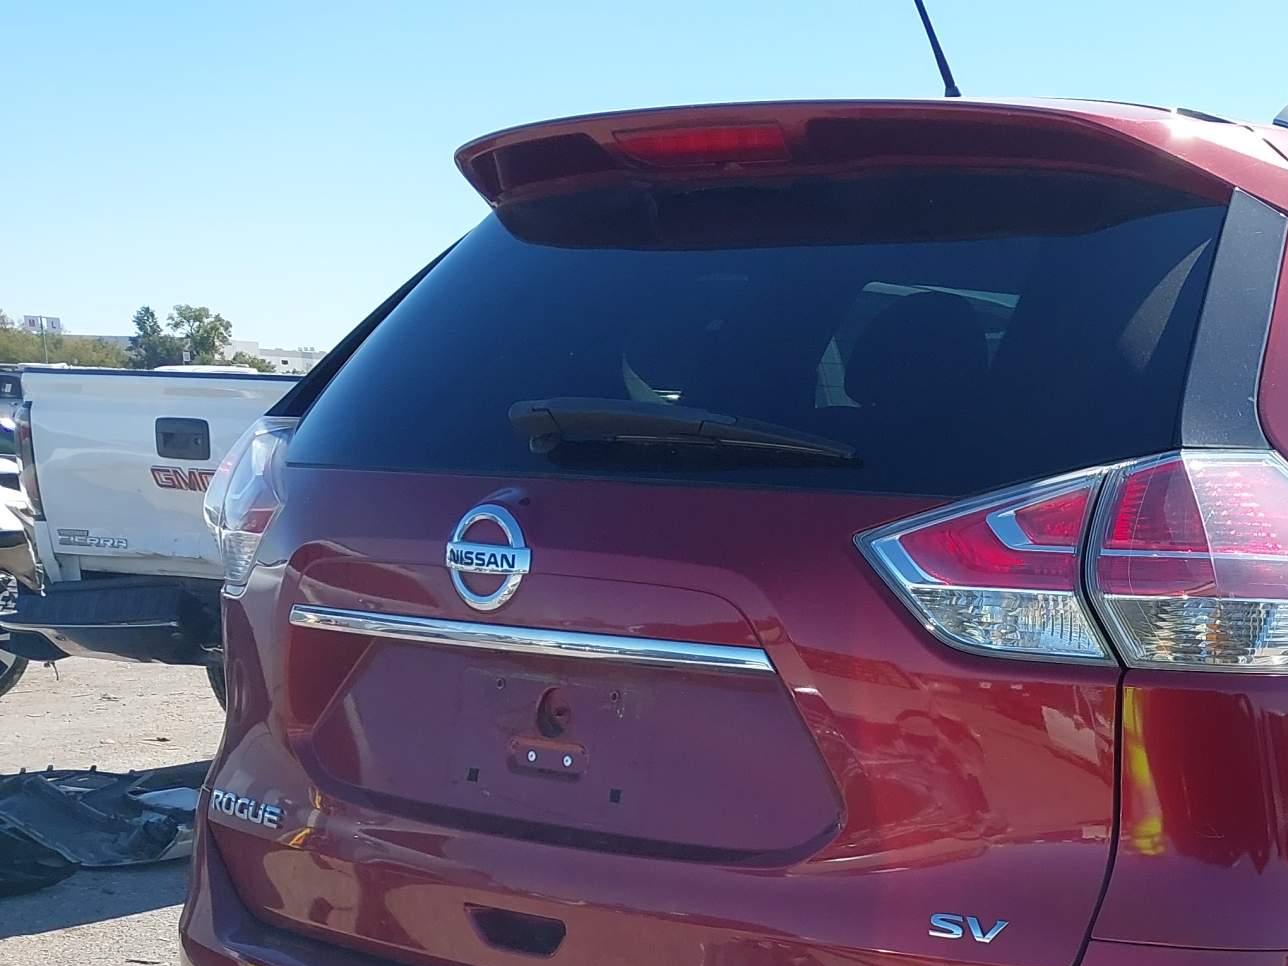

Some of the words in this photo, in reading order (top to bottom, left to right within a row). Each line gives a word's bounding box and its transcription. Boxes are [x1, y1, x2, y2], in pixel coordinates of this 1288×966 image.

[448, 548, 516, 569] NISSAN
[212, 789, 282, 829] ROGUE
[928, 912, 1009, 944] SV
